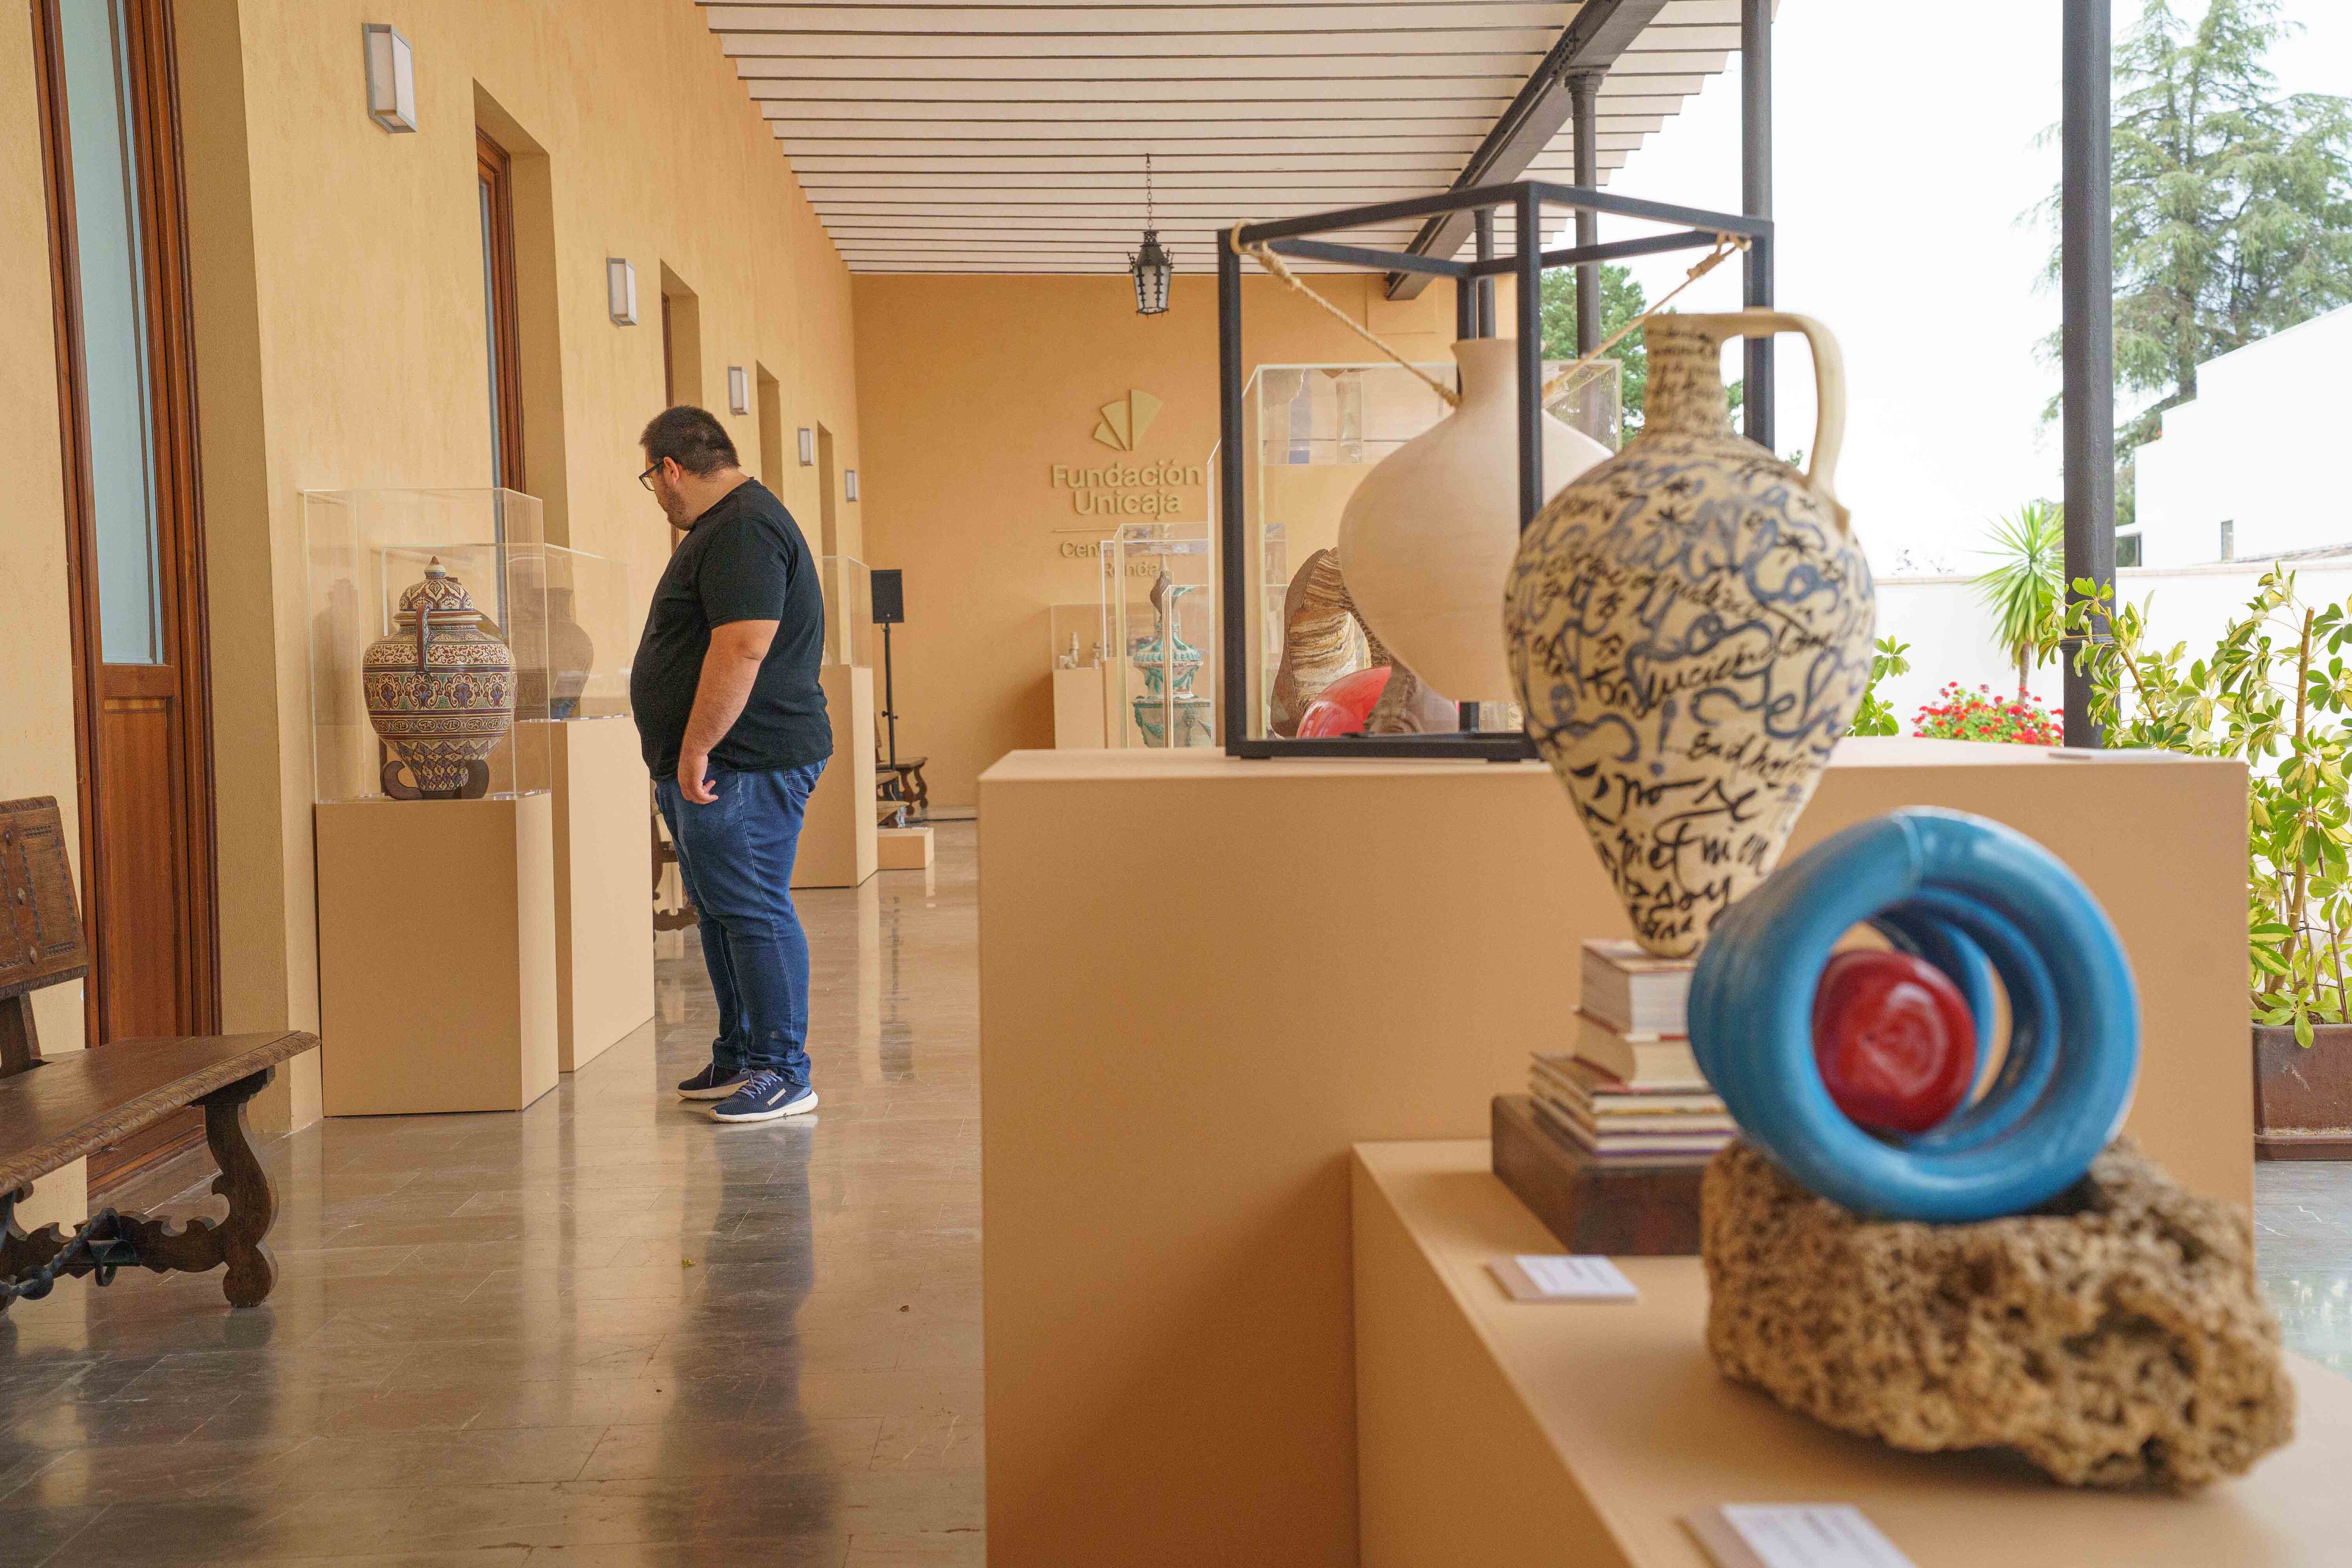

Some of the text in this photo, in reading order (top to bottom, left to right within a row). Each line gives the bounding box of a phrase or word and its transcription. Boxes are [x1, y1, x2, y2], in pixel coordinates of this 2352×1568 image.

[1051, 459, 1201, 489] Fundación
[1073, 489, 1183, 520] Unicaja
[1104, 561, 1160, 578] Rnda
